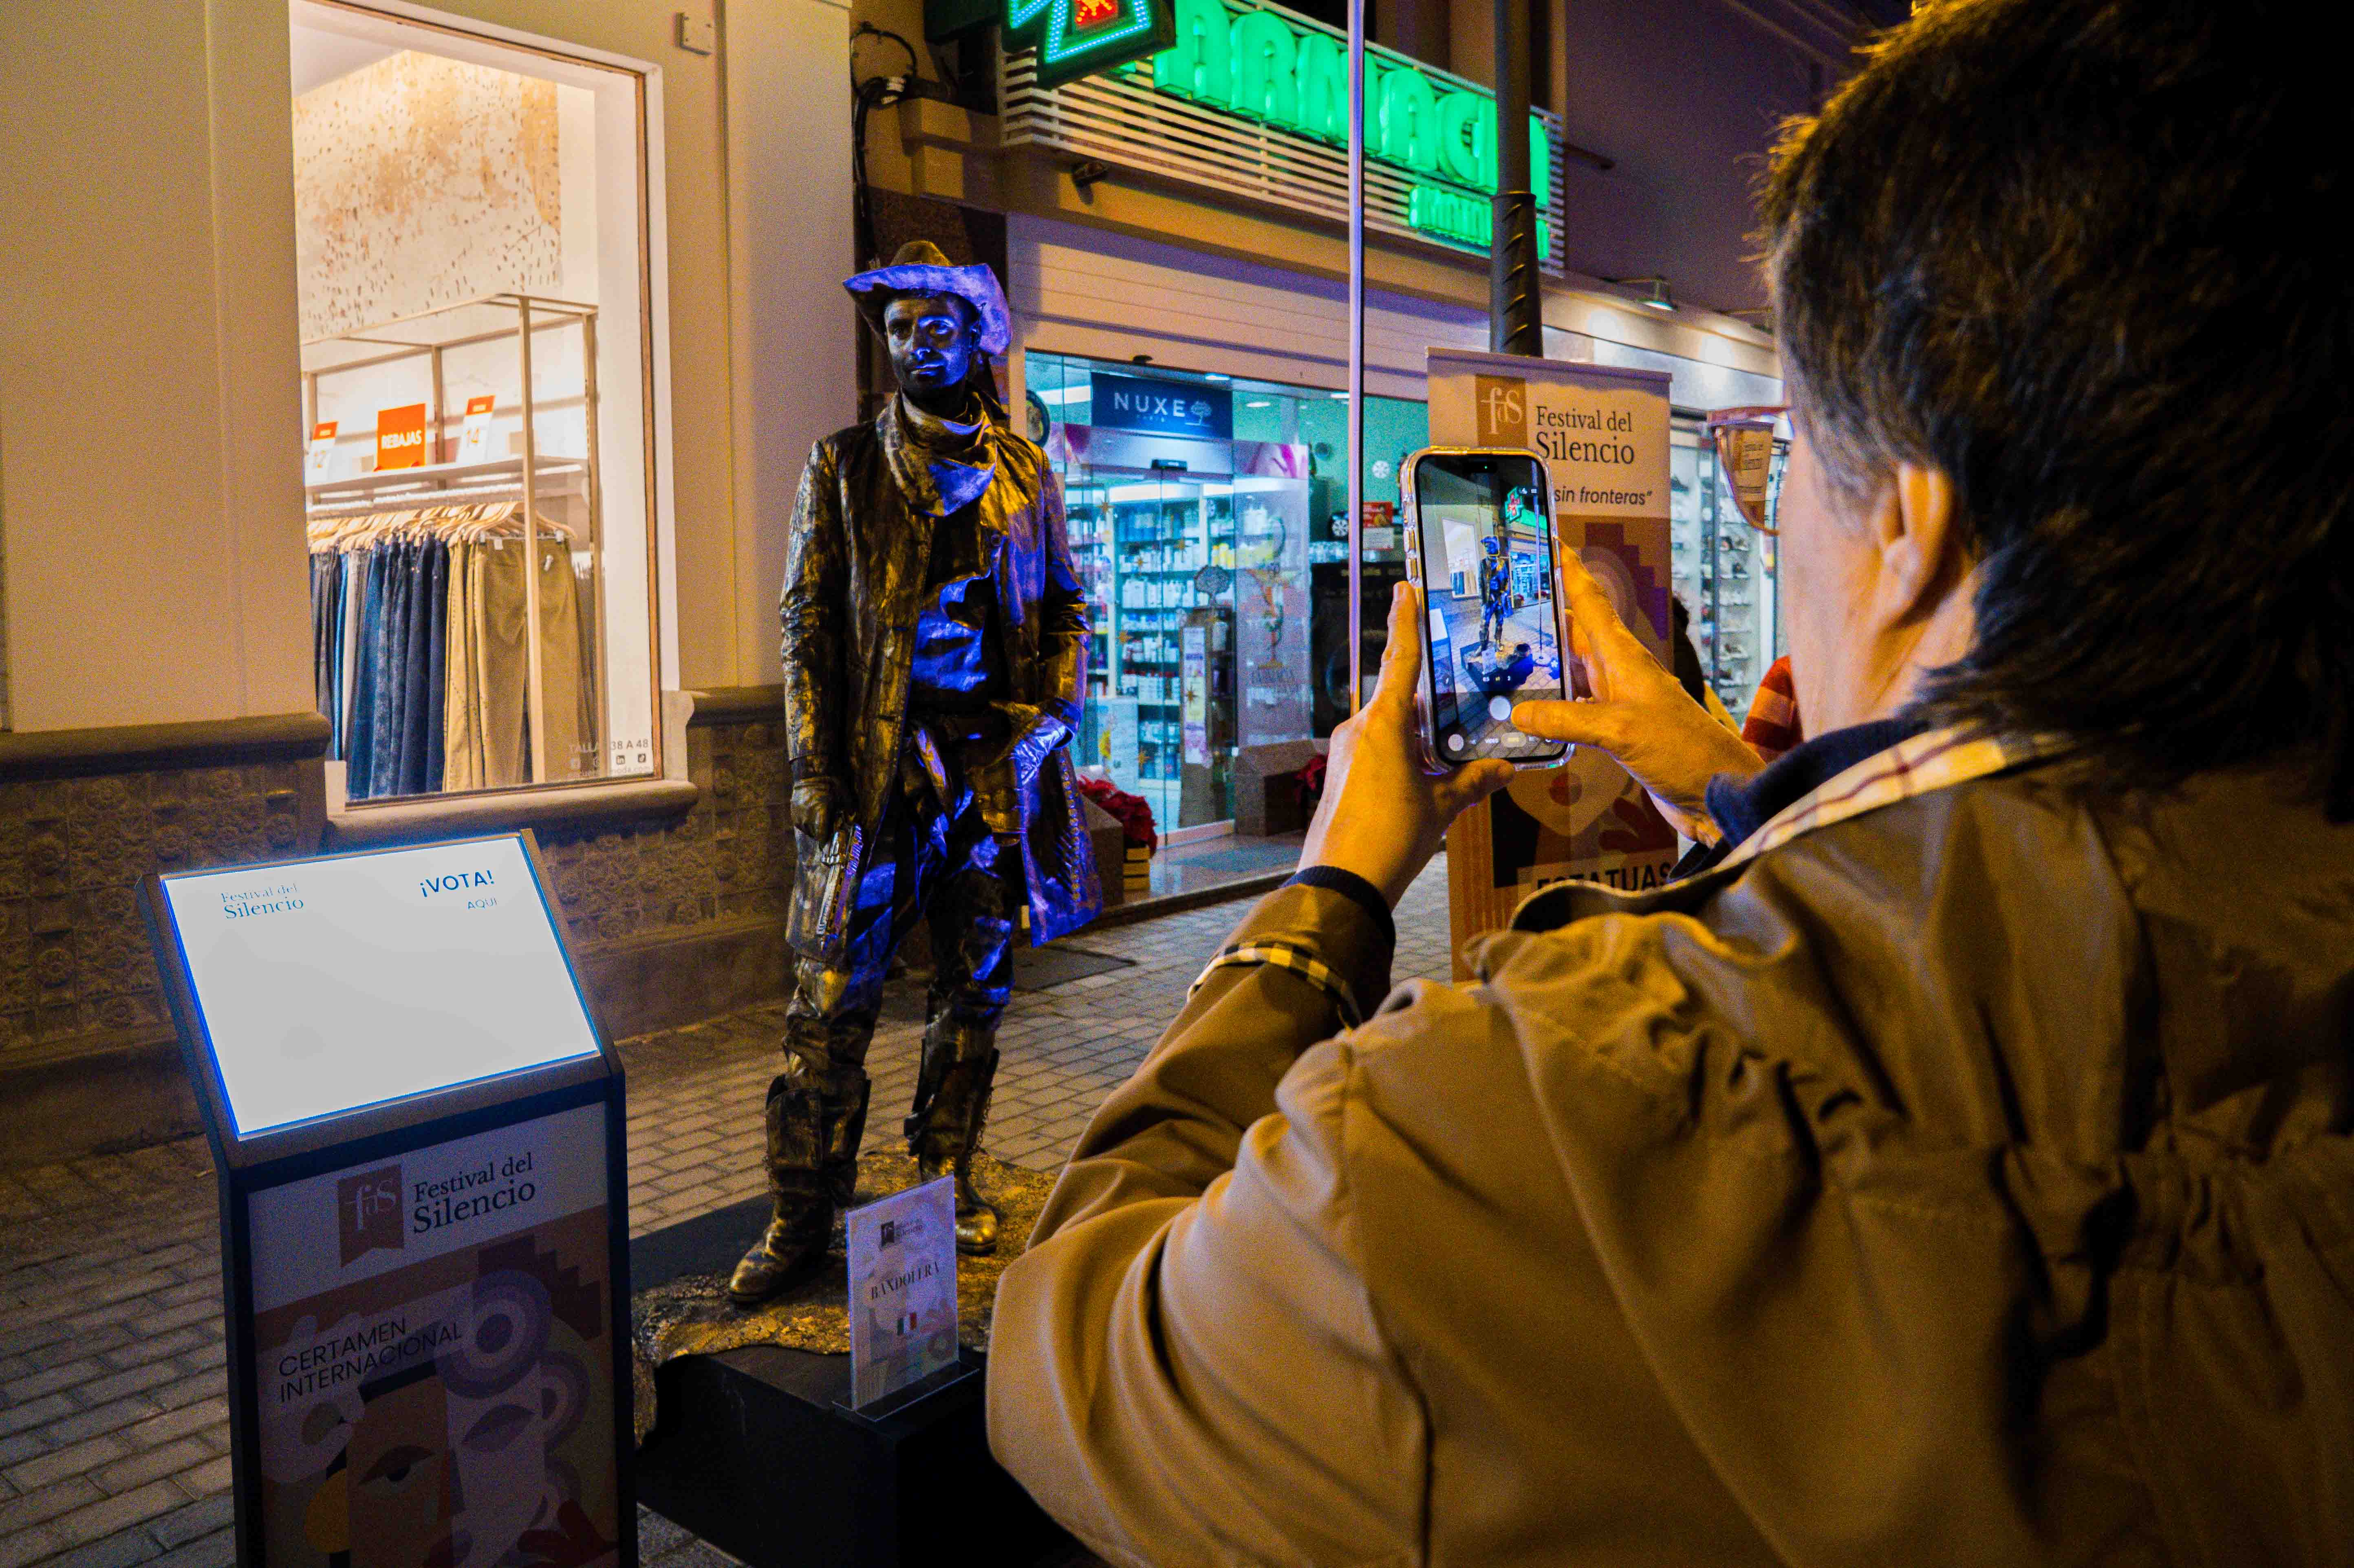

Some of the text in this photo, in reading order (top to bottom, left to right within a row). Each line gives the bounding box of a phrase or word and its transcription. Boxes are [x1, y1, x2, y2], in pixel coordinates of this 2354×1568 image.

[1119, 0, 1549, 206] ARMACI
[1114, 392, 1186, 417] NUXE
[1536, 405, 1633, 432] Festival del
[381, 430, 422, 449] REBAJAS
[1536, 431, 1635, 465] Silencio
[1554, 486, 1575, 502] sin
[626, 740, 634, 749] A
[636, 739, 649, 748] 48
[420, 870, 494, 898] ¡VOTA!
[1537, 861, 1672, 891] ATUAS
[220, 883, 298, 903] Festival del
[224, 896, 304, 919] Silencio
[414, 1152, 533, 1203] Festival del
[413, 1179, 536, 1233] Silencio
[279, 1317, 406, 1377] CERTAMEN
[280, 1323, 462, 1403] INTERNACIONAL
